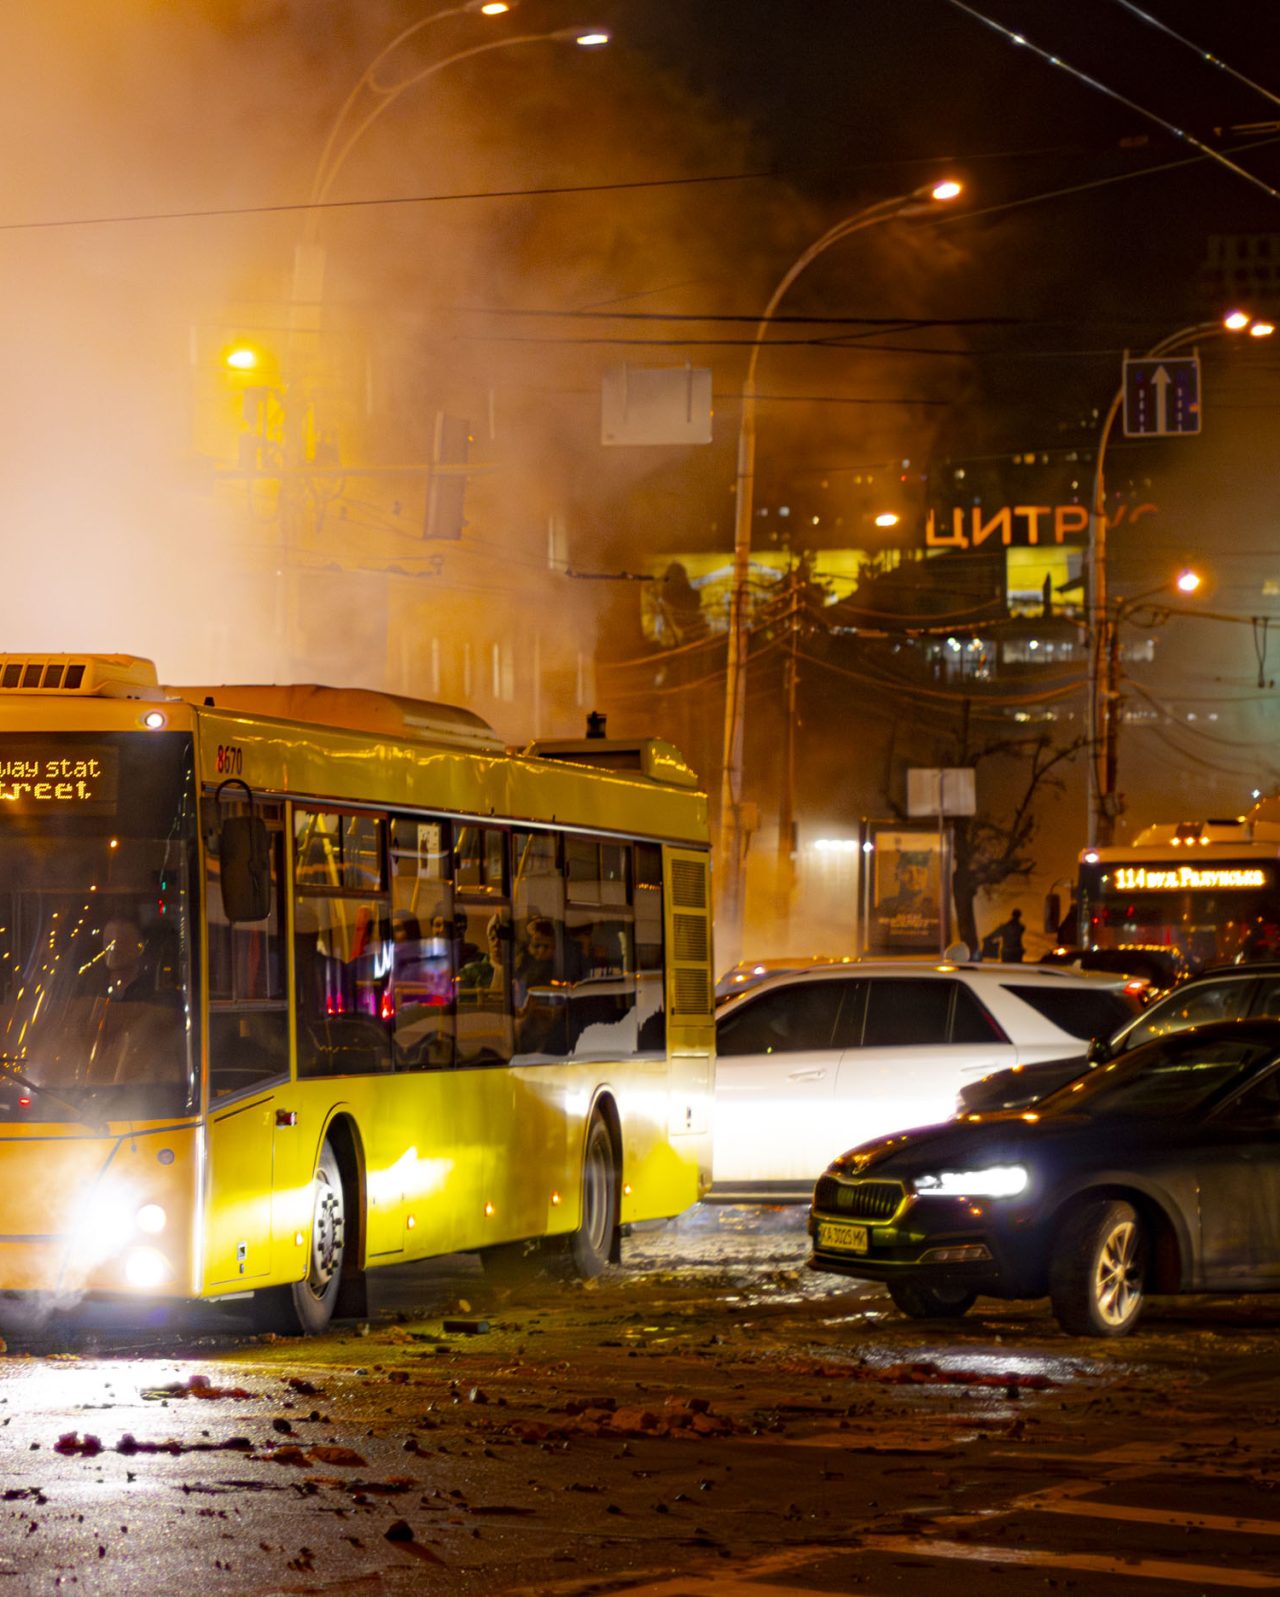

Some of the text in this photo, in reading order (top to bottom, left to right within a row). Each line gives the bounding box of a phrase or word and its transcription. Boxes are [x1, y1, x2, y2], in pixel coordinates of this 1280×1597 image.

[44, 758, 101, 778] stat
[217, 744, 242, 775] 8670
[1115, 868, 1145, 889] 114
